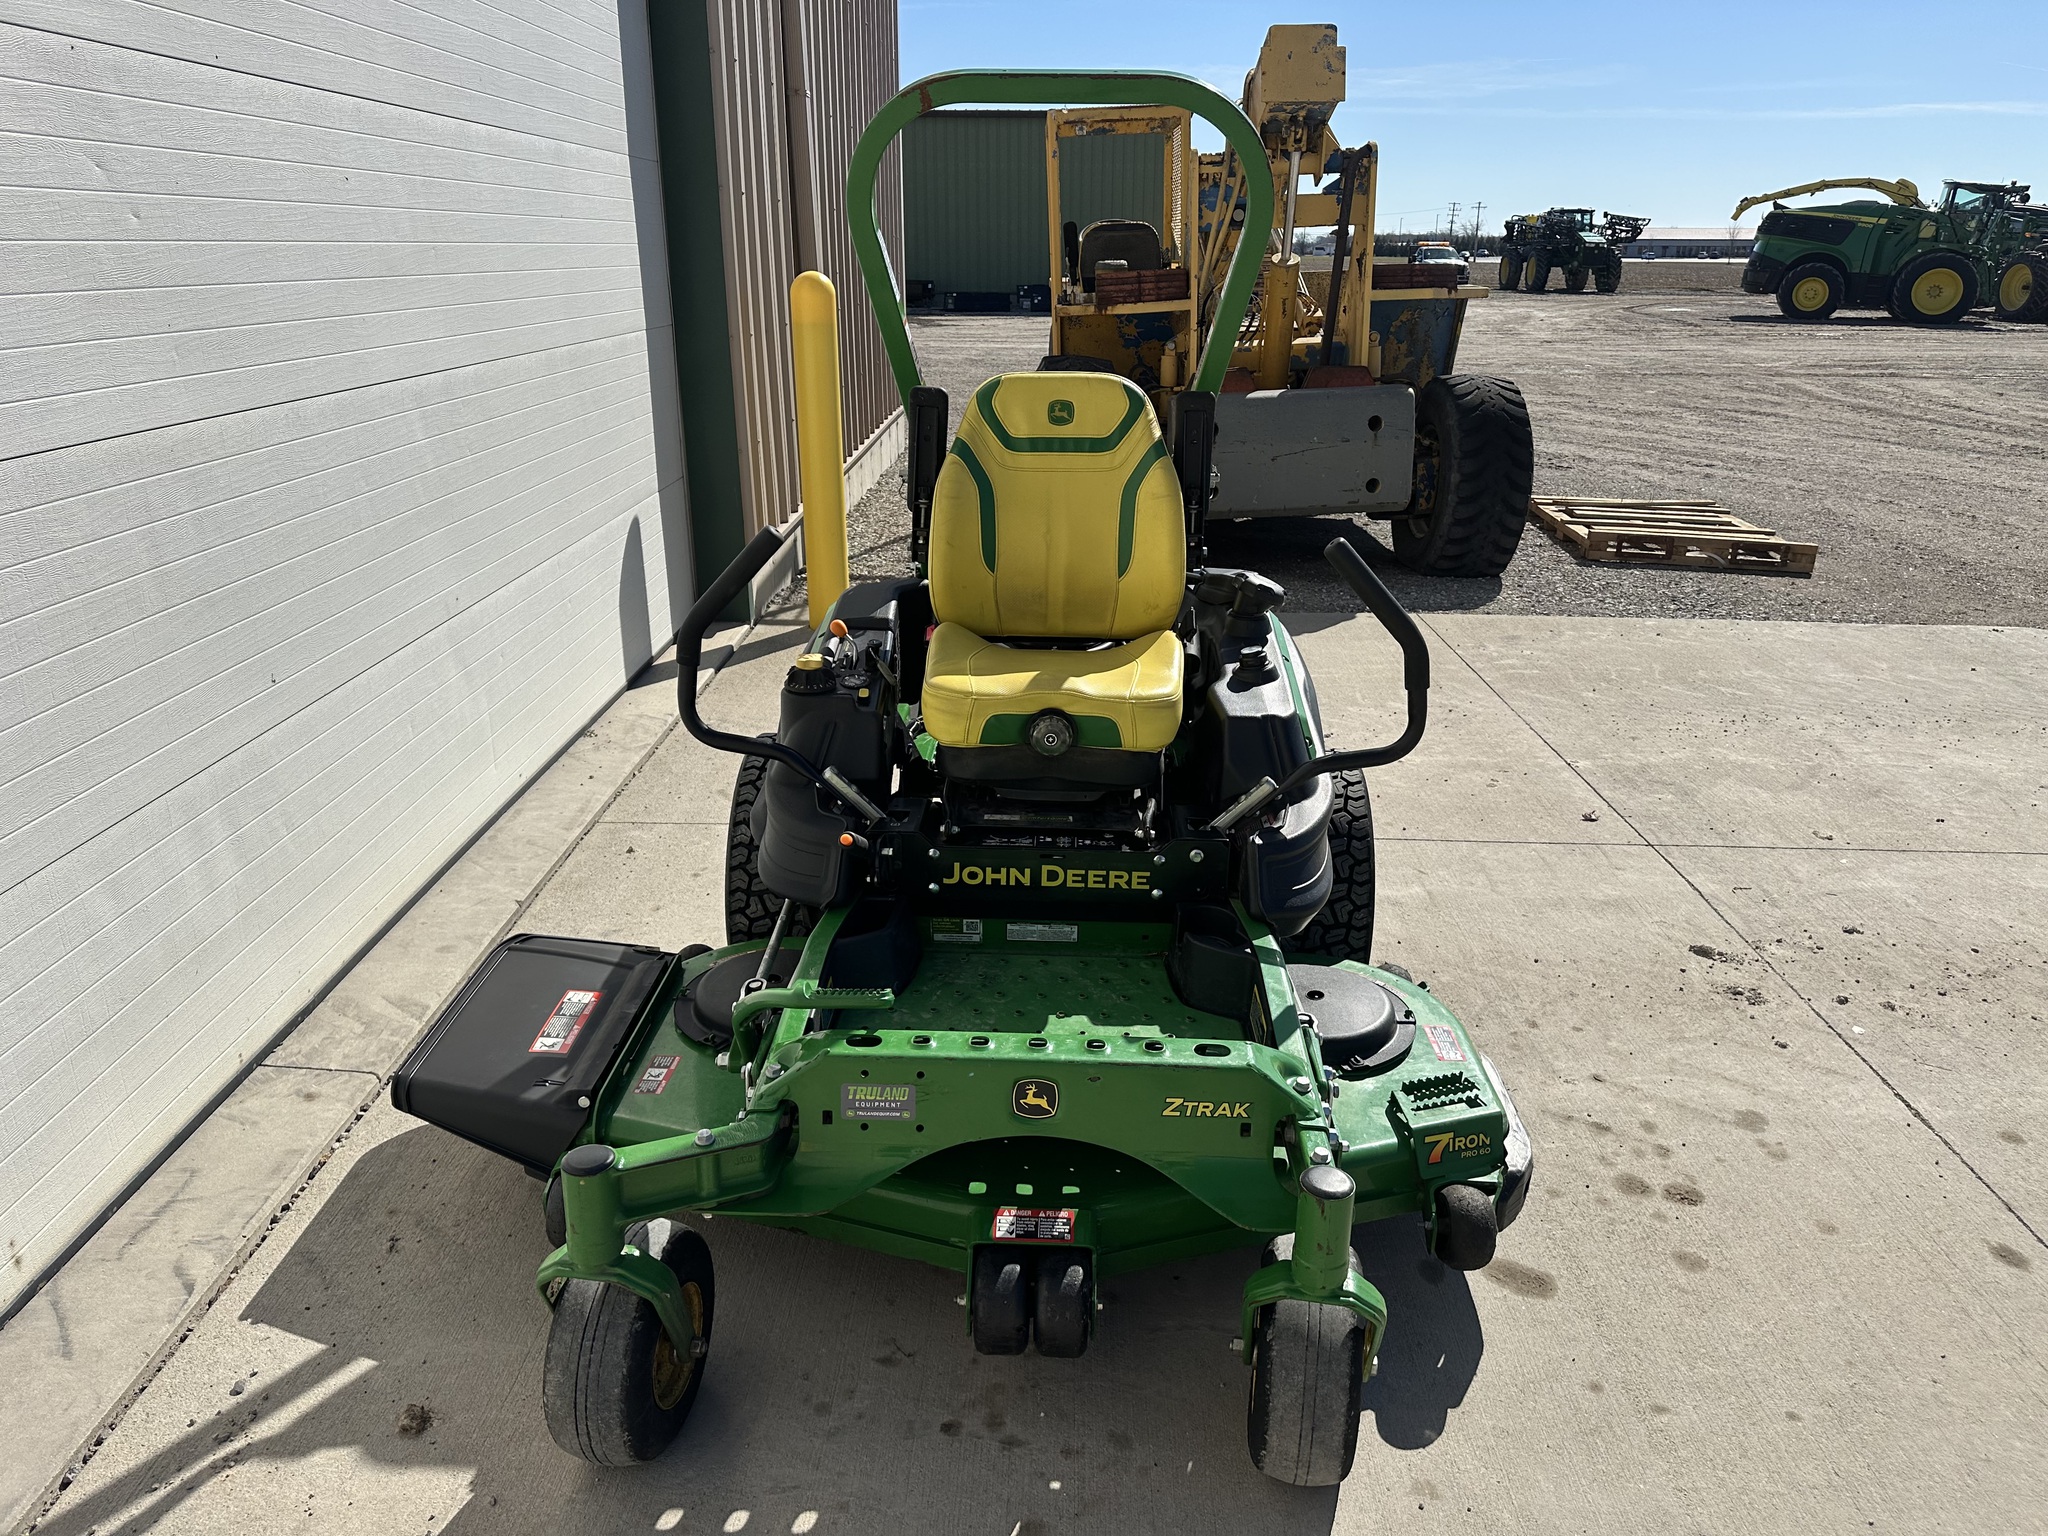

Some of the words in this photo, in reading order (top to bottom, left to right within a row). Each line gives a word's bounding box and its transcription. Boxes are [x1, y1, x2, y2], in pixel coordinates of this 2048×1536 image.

[943, 862, 1031, 886] JOHN
[1041, 865, 1150, 889] DEERE
[848, 1086, 909, 1101] TRULAND
[1162, 1097, 1251, 1118] ZTRAK
[1424, 1131, 1455, 1164] 7
[1449, 1133, 1491, 1152] IRON
[1461, 1150, 1478, 1159] PRO
[1479, 1147, 1491, 1155] 60
[1046, 1210, 1069, 1218] PELIGRO
